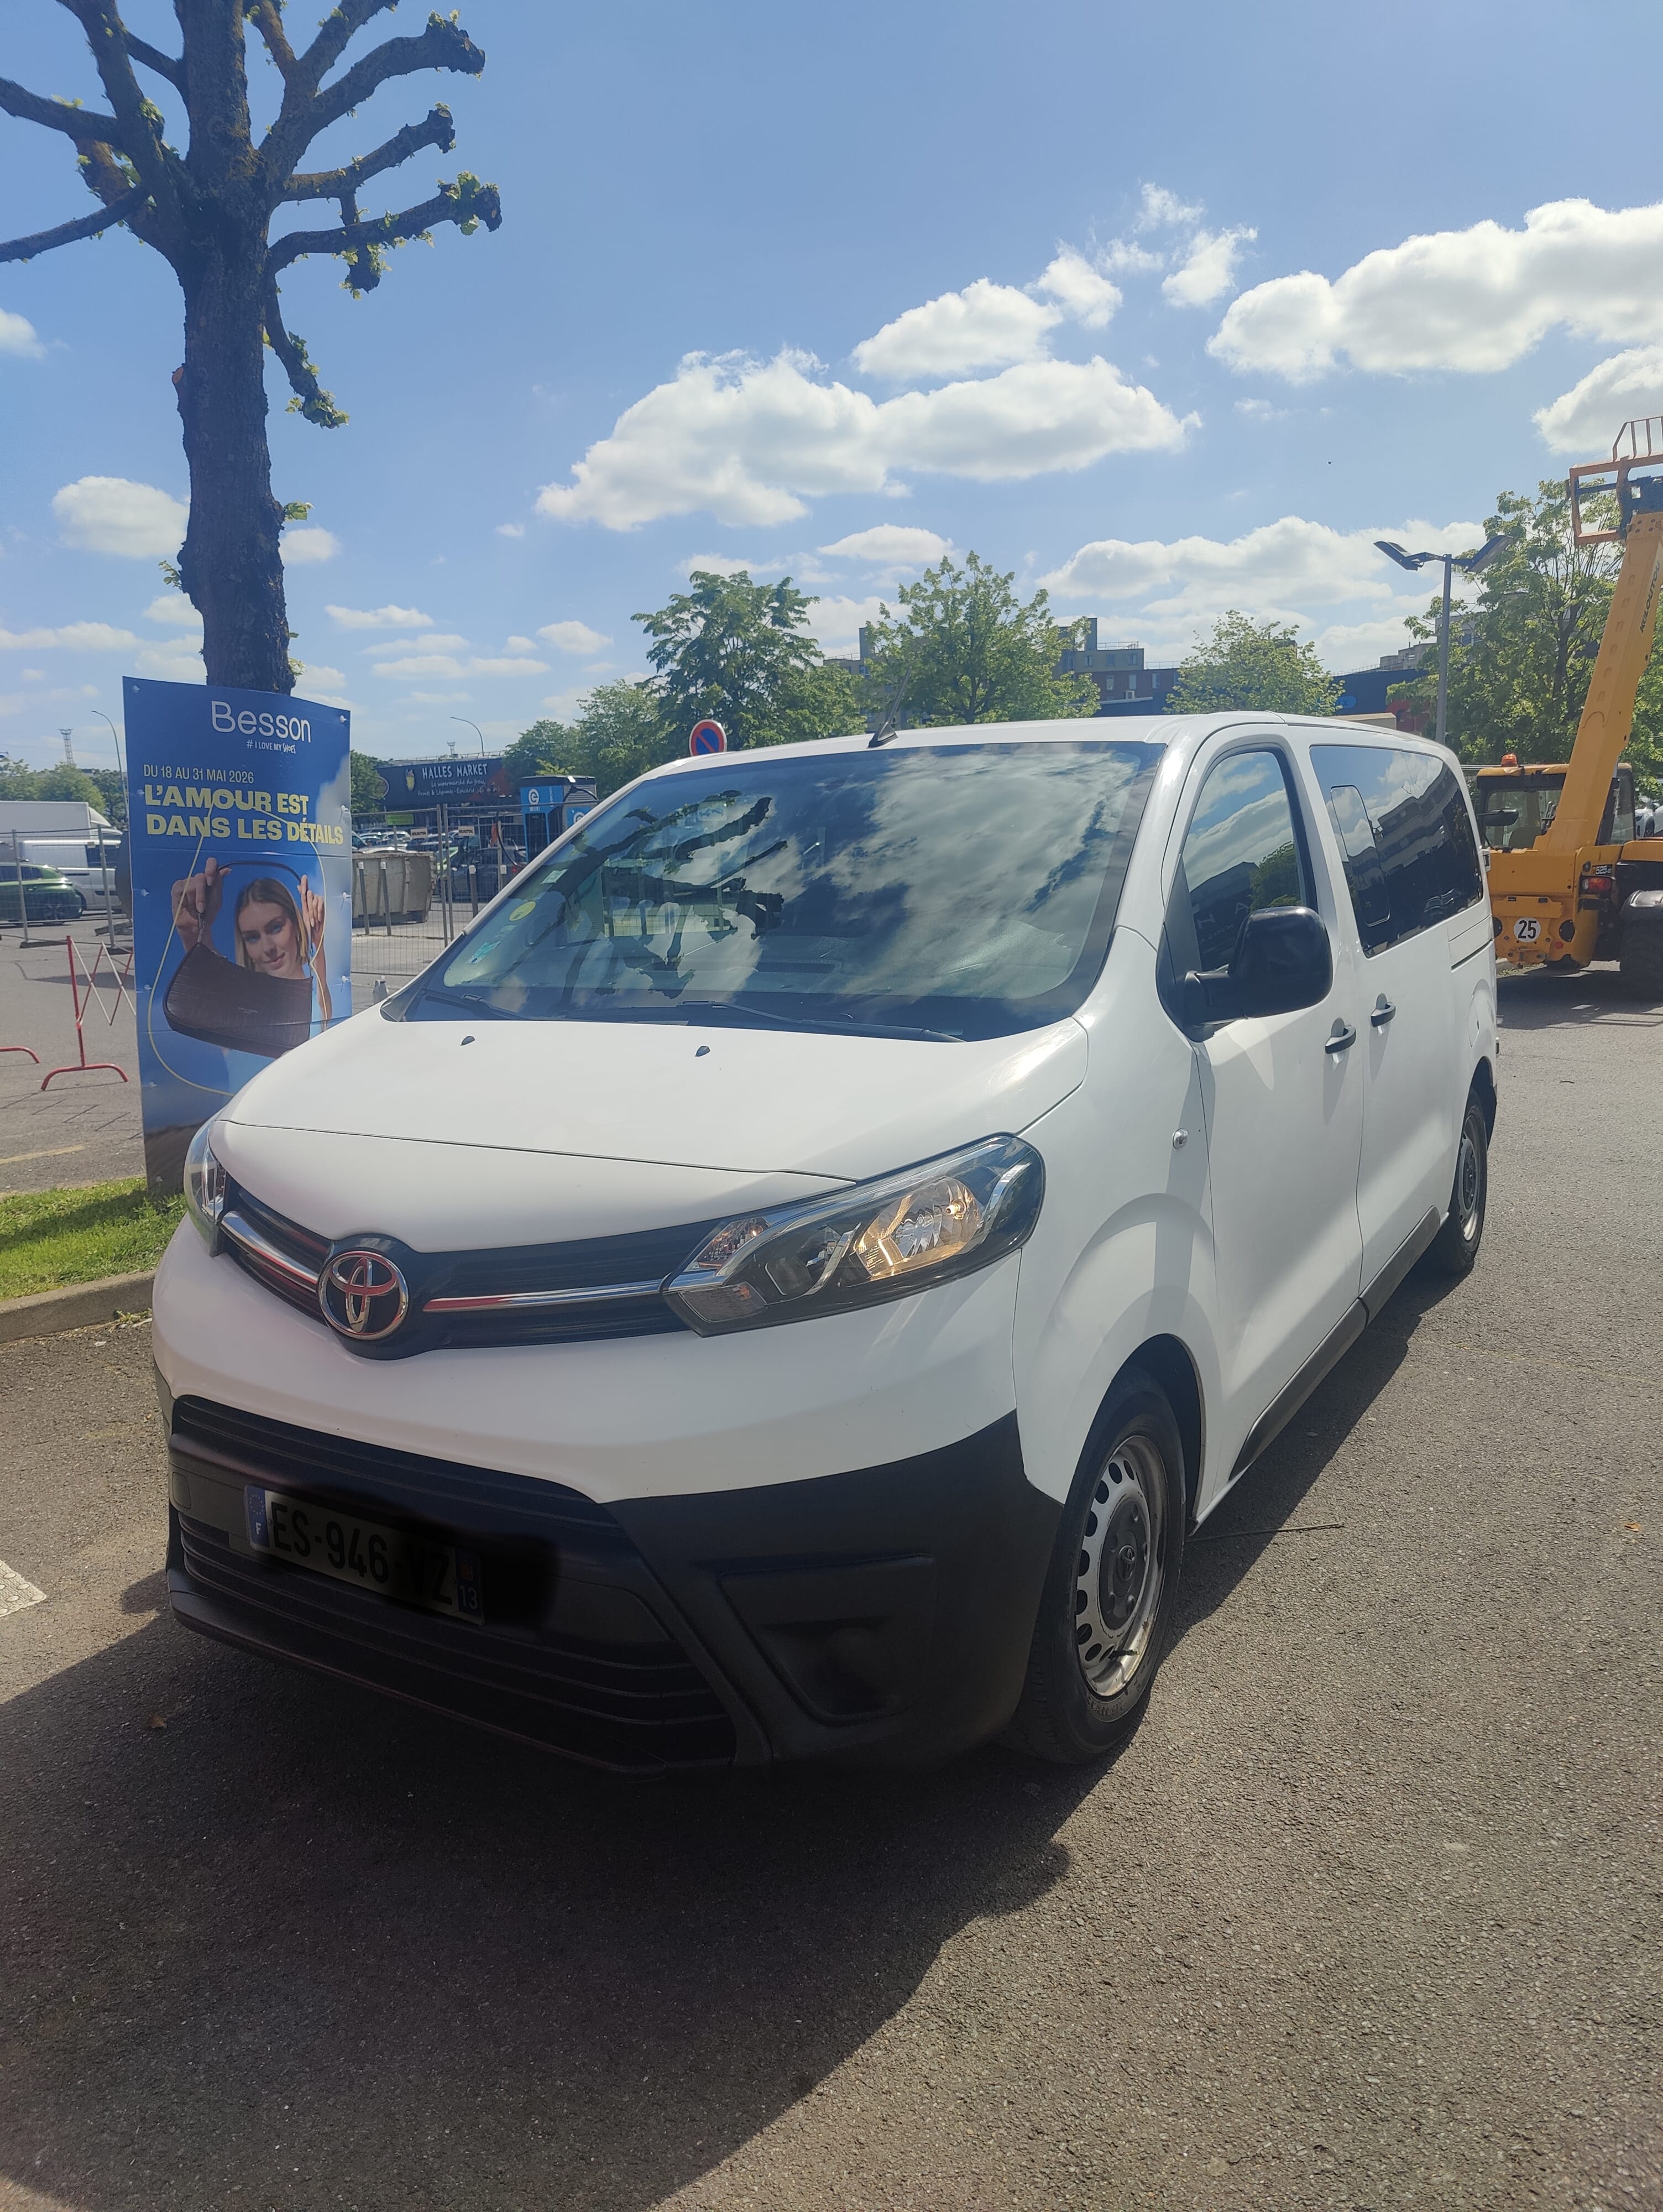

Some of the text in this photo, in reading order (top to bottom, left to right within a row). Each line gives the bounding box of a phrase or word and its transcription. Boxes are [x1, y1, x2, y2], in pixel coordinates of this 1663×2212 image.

[211, 701, 312, 743] Besson
[258, 742, 273, 750] LOVE
[274, 743, 283, 752] MY
[282, 743, 296, 754] SHOES
[144, 764, 254, 784] DU 18 AU 31 MAI 2026
[422, 764, 488, 779] HALLES MARKET
[144, 784, 309, 815] L'AMOUR EST
[146, 813, 344, 845] DANS LES DÉTAILS
[1518, 920, 1537, 939] 25
[255, 1522, 262, 1536] F
[458, 1584, 478, 1610] 13
